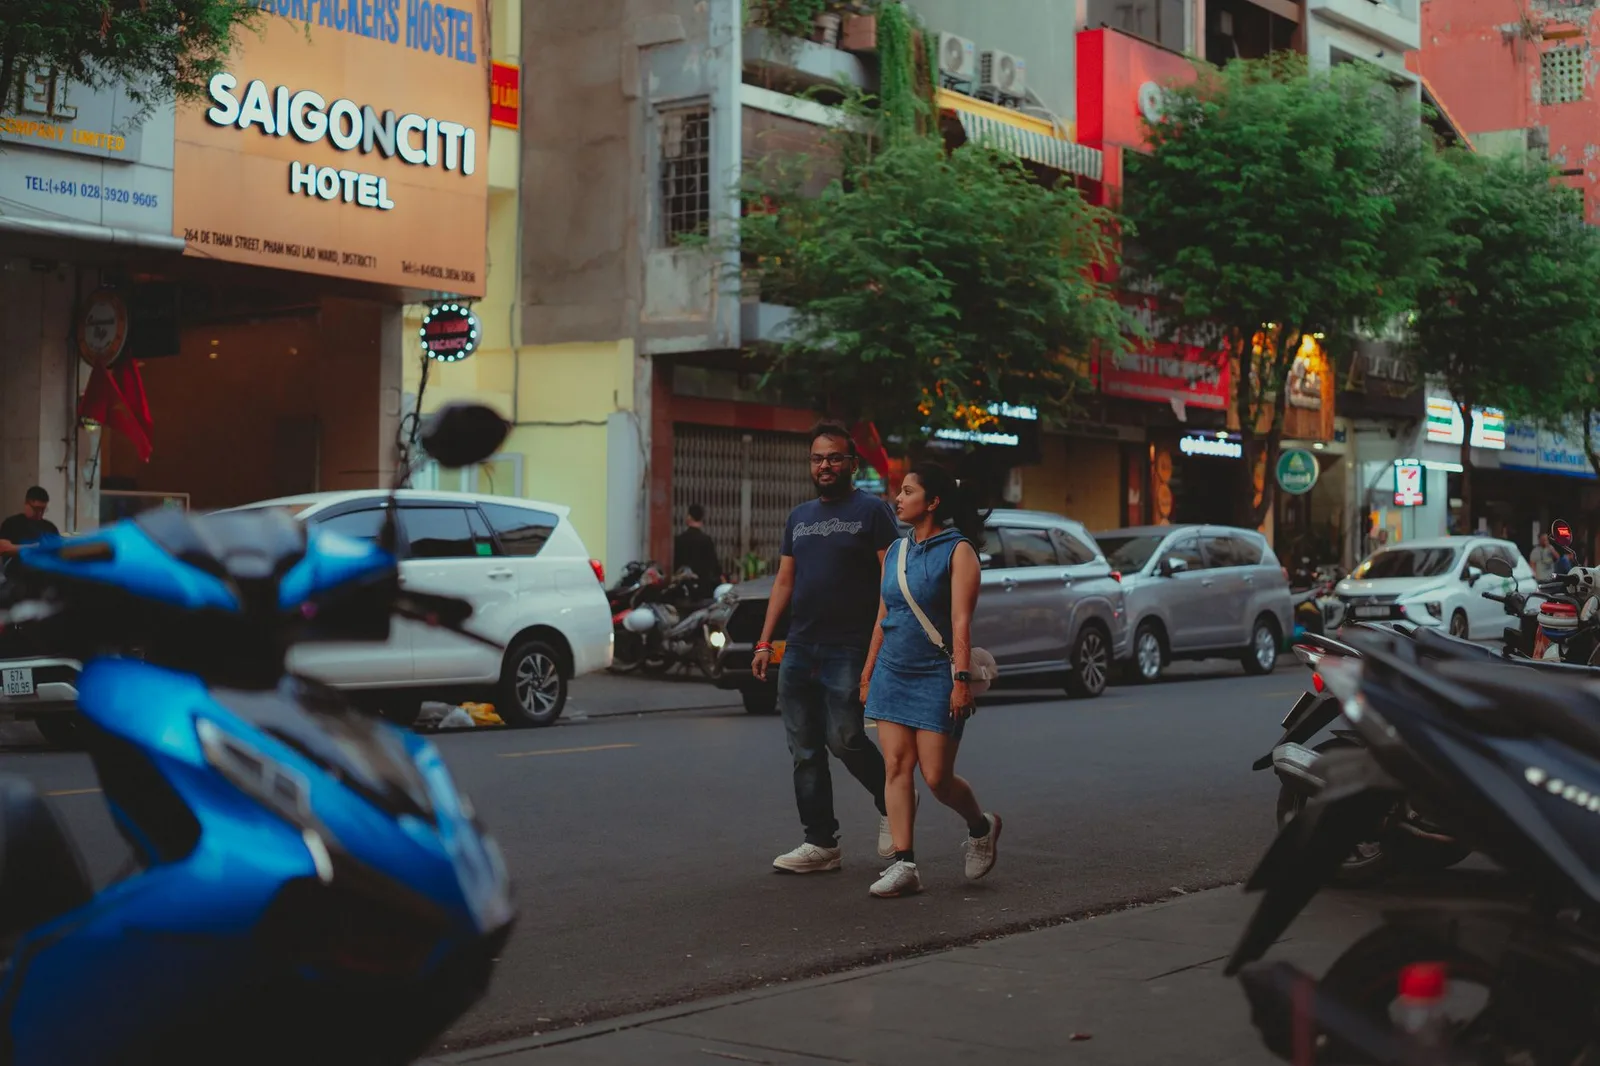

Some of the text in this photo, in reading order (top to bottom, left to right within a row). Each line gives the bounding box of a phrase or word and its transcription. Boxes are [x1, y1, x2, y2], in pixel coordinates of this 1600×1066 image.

[406, 0, 477, 64] HOSTEL
[71, 128, 125, 152] LIMITED
[290, 160, 395, 210] HOTEL
[133, 192, 158, 208] 9605
[184, 227, 198, 242] 264
[200, 230, 210, 244] DE
[212, 231, 233, 248] THAM
[263, 239, 284, 255] PHAM
[10, 670, 24, 681] 67A
